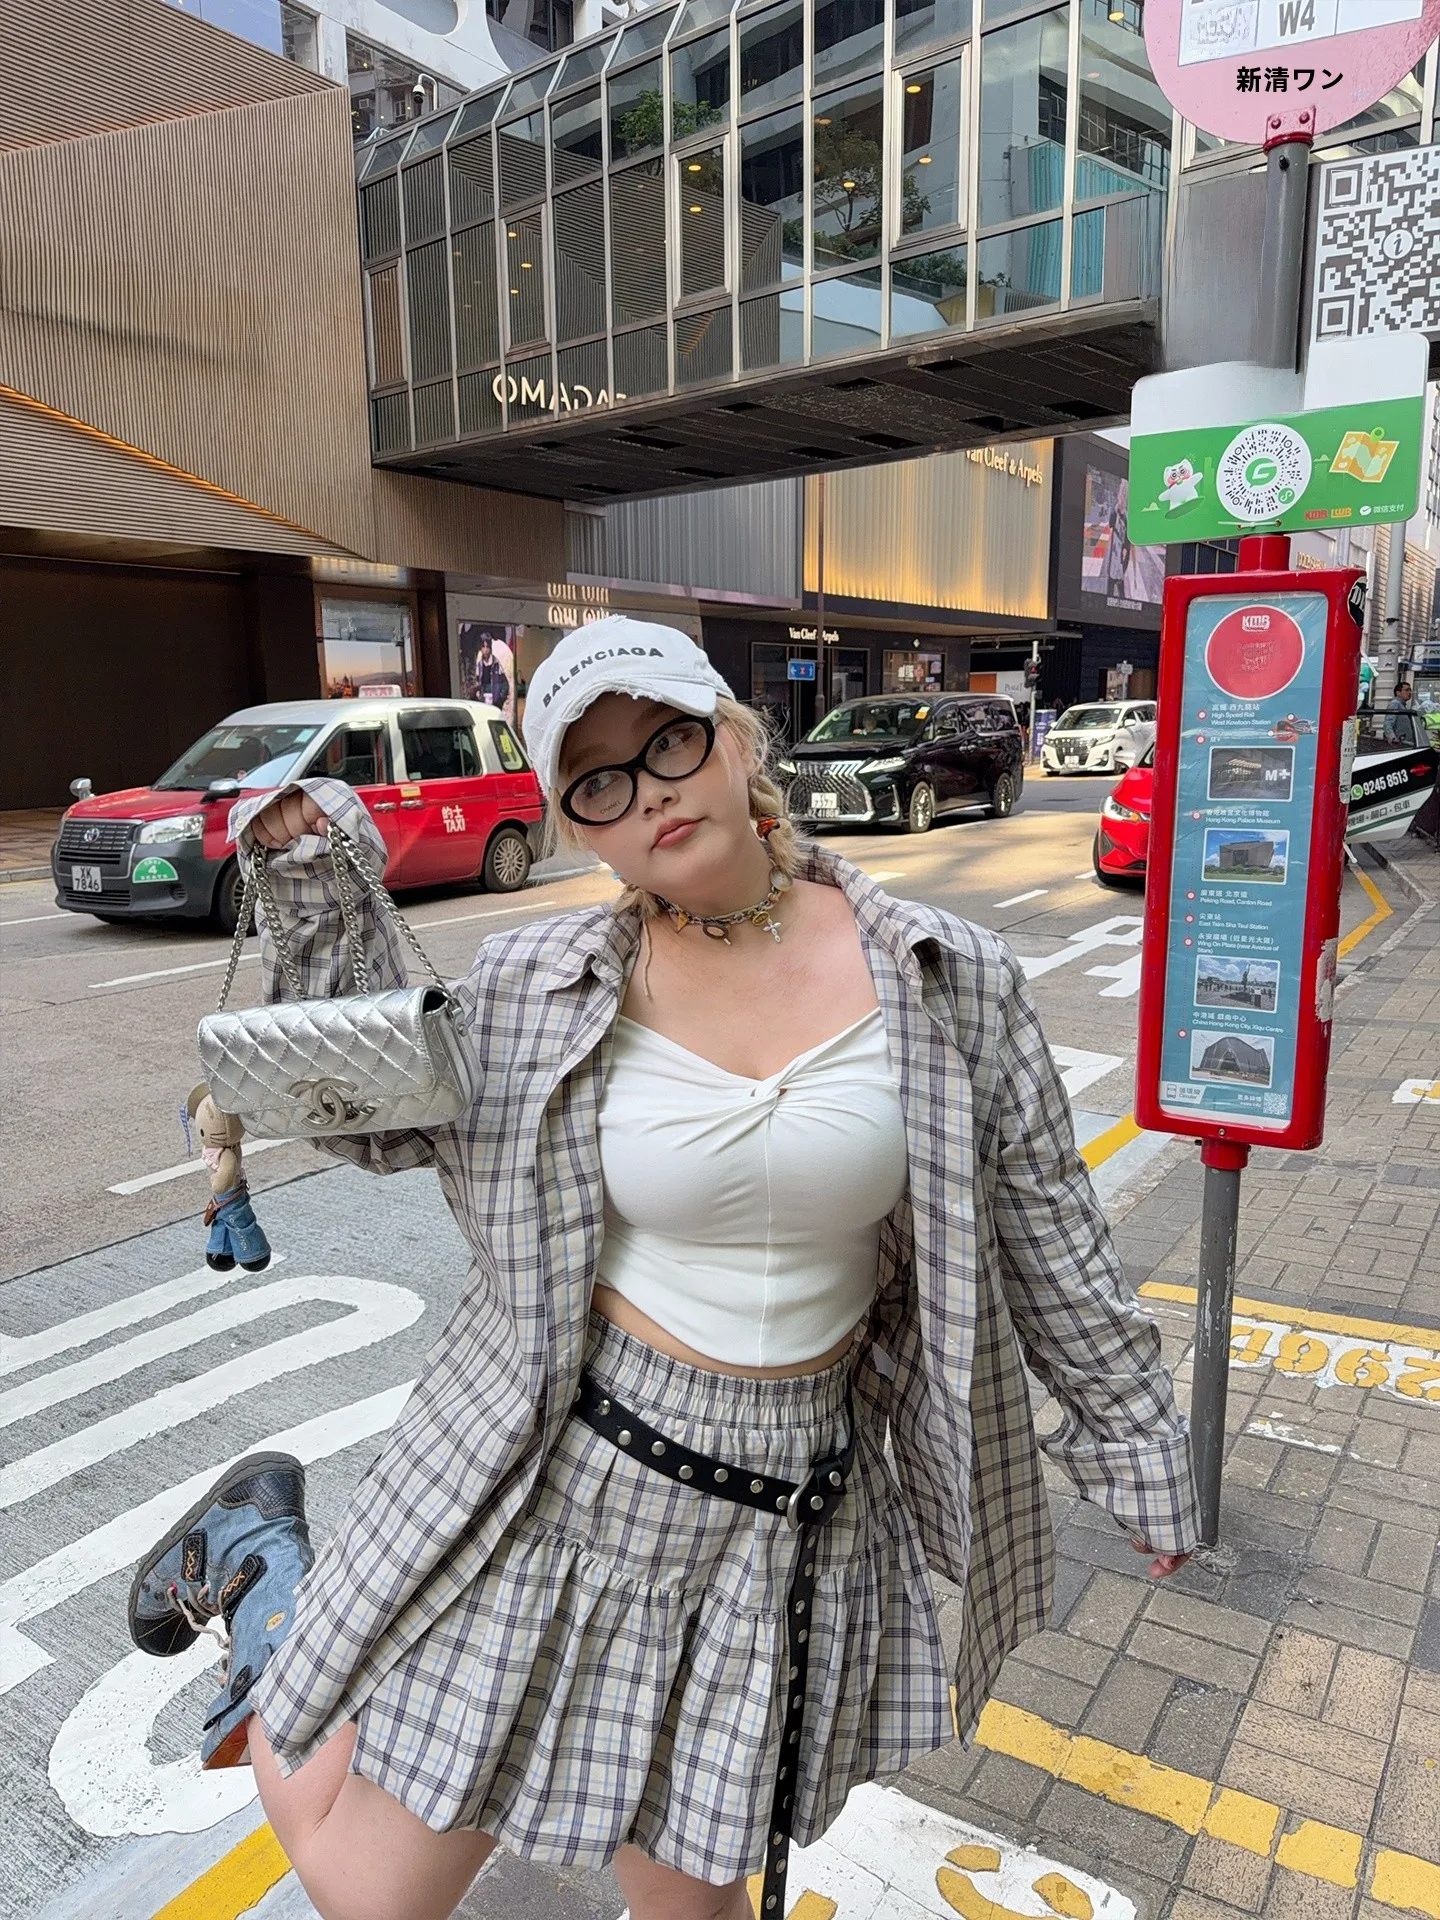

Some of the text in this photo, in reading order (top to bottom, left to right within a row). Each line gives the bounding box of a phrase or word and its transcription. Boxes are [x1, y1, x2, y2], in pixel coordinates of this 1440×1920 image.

[1279, 0, 1315, 37] W4
[984, 447, 1009, 471] Cleef
[1009, 459, 1017, 475] &
[1018, 459, 1043, 488] Arpels
[542, 647, 664, 708] BALENCIAGA
[1265, 768, 1291, 781] M+
[1363, 769, 1409, 796] 9245 8513
[441, 804, 464, 820] 的士
[600, 800, 622, 815] CHANEL
[443, 817, 466, 833] TAXI
[80, 867, 92, 878] XK
[148, 865, 157, 875] 4
[75, 878, 100, 891] 7846
[1197, 940, 1212, 948] Wing
[1208, 1020, 1224, 1028] Hong
[1265, 1025, 1284, 1033] Centre
